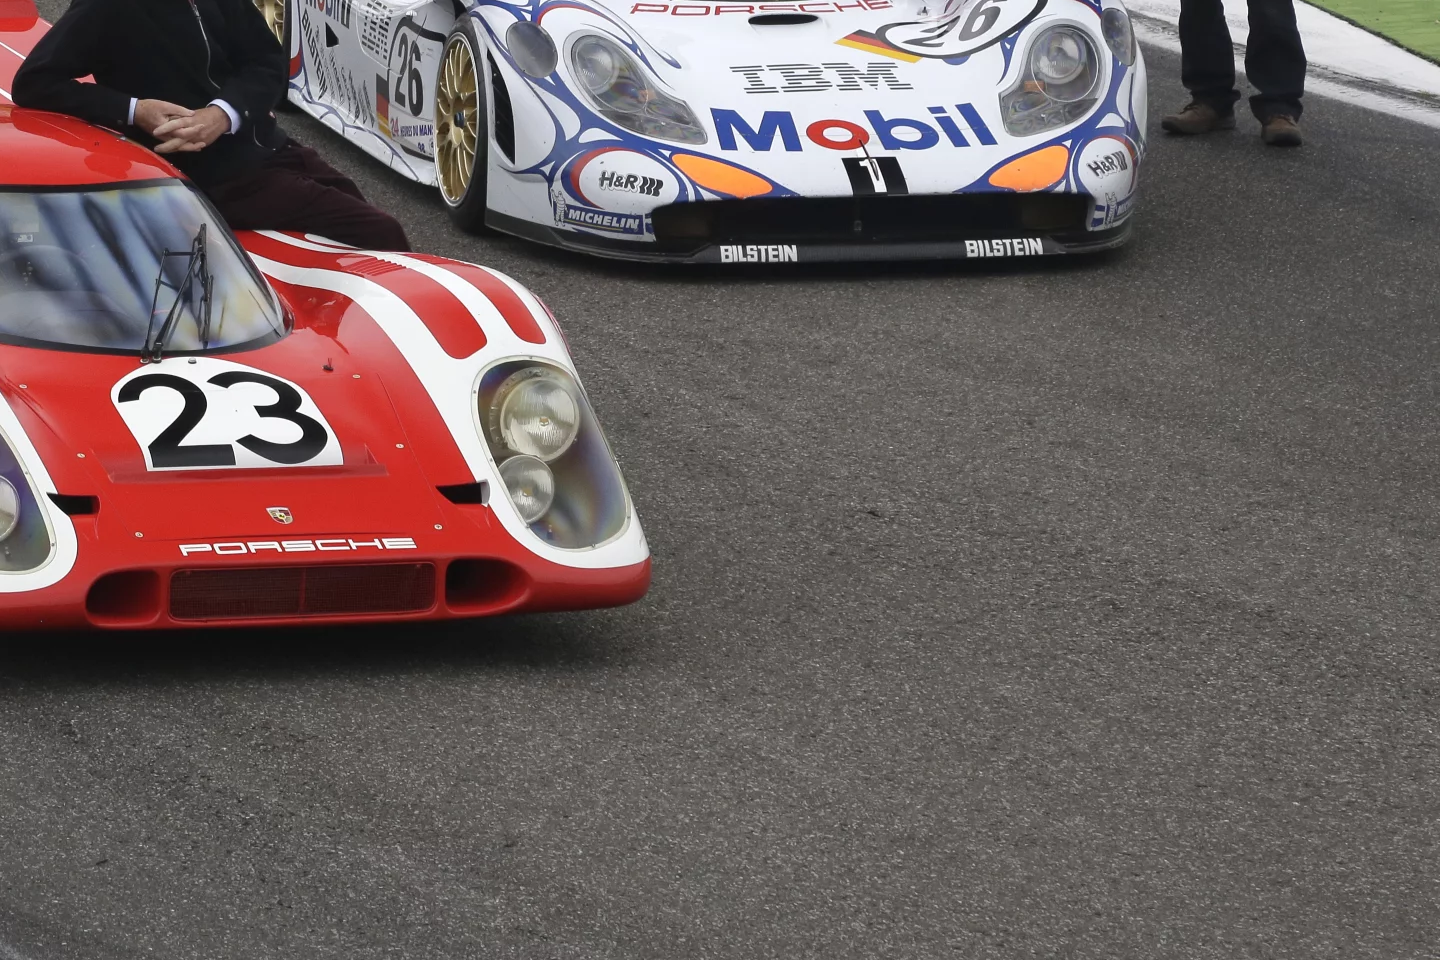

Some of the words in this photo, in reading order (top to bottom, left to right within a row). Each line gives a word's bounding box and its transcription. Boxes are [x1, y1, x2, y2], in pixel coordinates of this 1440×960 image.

[301, 7, 328, 101] BILSTEIN
[394, 32, 424, 117] 26
[728, 62, 915, 94] IBM
[391, 117, 399, 138] 24
[710, 102, 999, 152] Mobil
[599, 171, 639, 191] H&R
[568, 209, 641, 229] MICHELIN
[720, 244, 798, 263] BILSTEIN
[964, 237, 1044, 258] BILSTEIN
[117, 370, 329, 466] 23
[177, 538, 418, 556] PORSCHE
